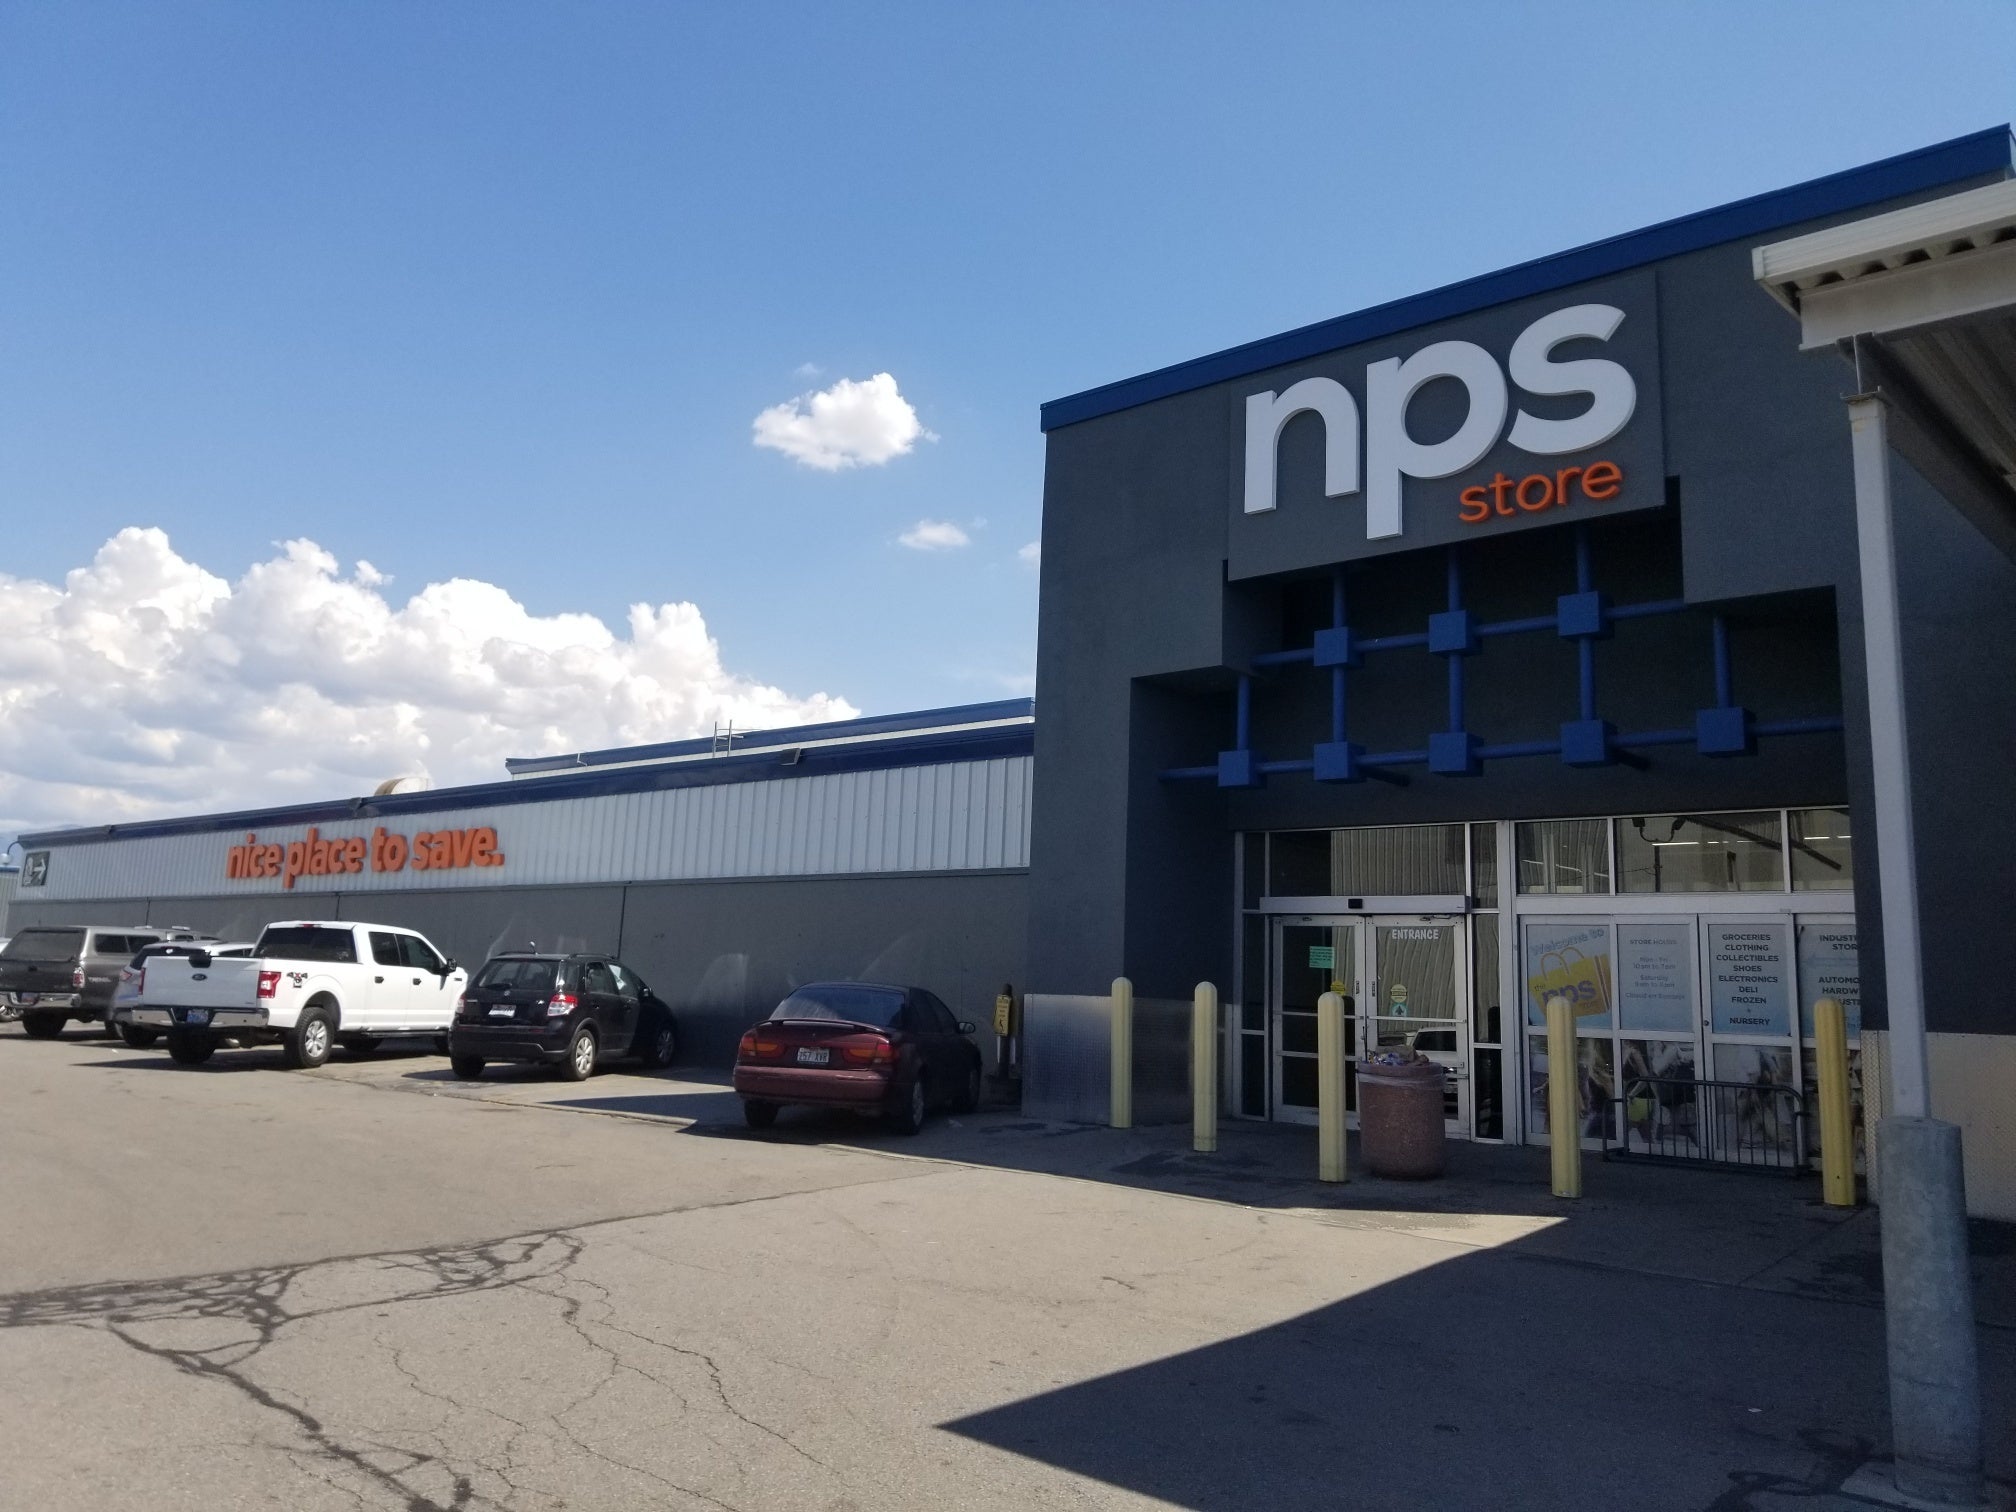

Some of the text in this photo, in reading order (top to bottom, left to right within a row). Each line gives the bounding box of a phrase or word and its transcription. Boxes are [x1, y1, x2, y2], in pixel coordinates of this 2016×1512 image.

[1243, 303, 1637, 540] nps
[1458, 460, 1623, 524] store
[226, 826, 505, 889] nice place to save.
[1391, 929, 1440, 940] ENTRANCE
[1716, 954, 1779, 962] COLLECTIBLES
[1718, 975, 1778, 983] ELECTRONICS
[1818, 976, 1860, 984] AUTOMO
[1821, 987, 1859, 995] HARDW
[1731, 996, 1767, 1004] FROZEN
[1729, 1017, 1770, 1025] NURSERY
